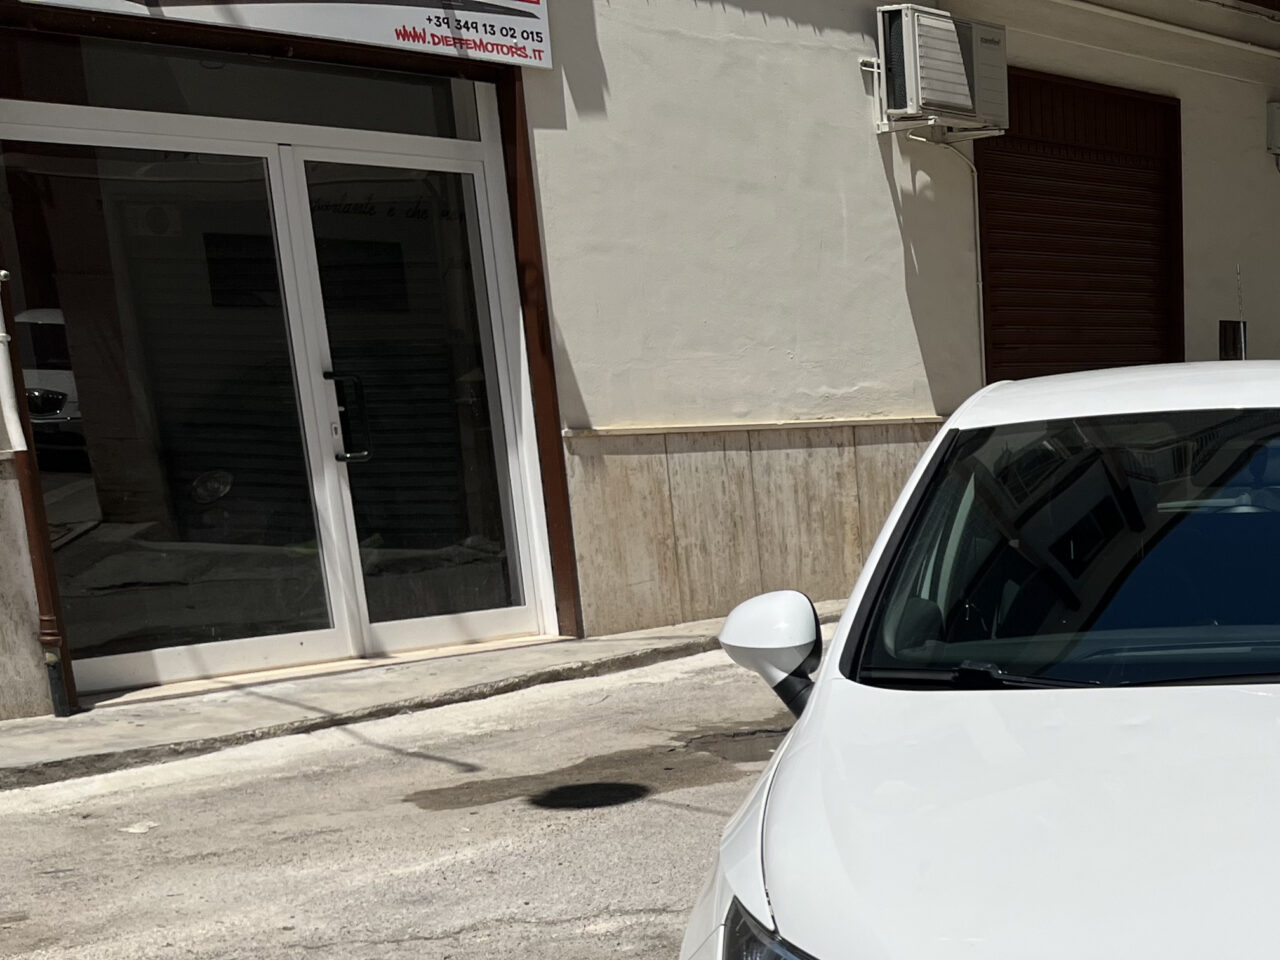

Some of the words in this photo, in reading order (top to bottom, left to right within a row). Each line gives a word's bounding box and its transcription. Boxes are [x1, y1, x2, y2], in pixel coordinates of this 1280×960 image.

[426, 15, 450, 29] +39
[454, 19, 478, 34] 349
[482, 23, 496, 36] 13
[500, 26, 517, 39] 02
[520, 29, 544, 43] 015
